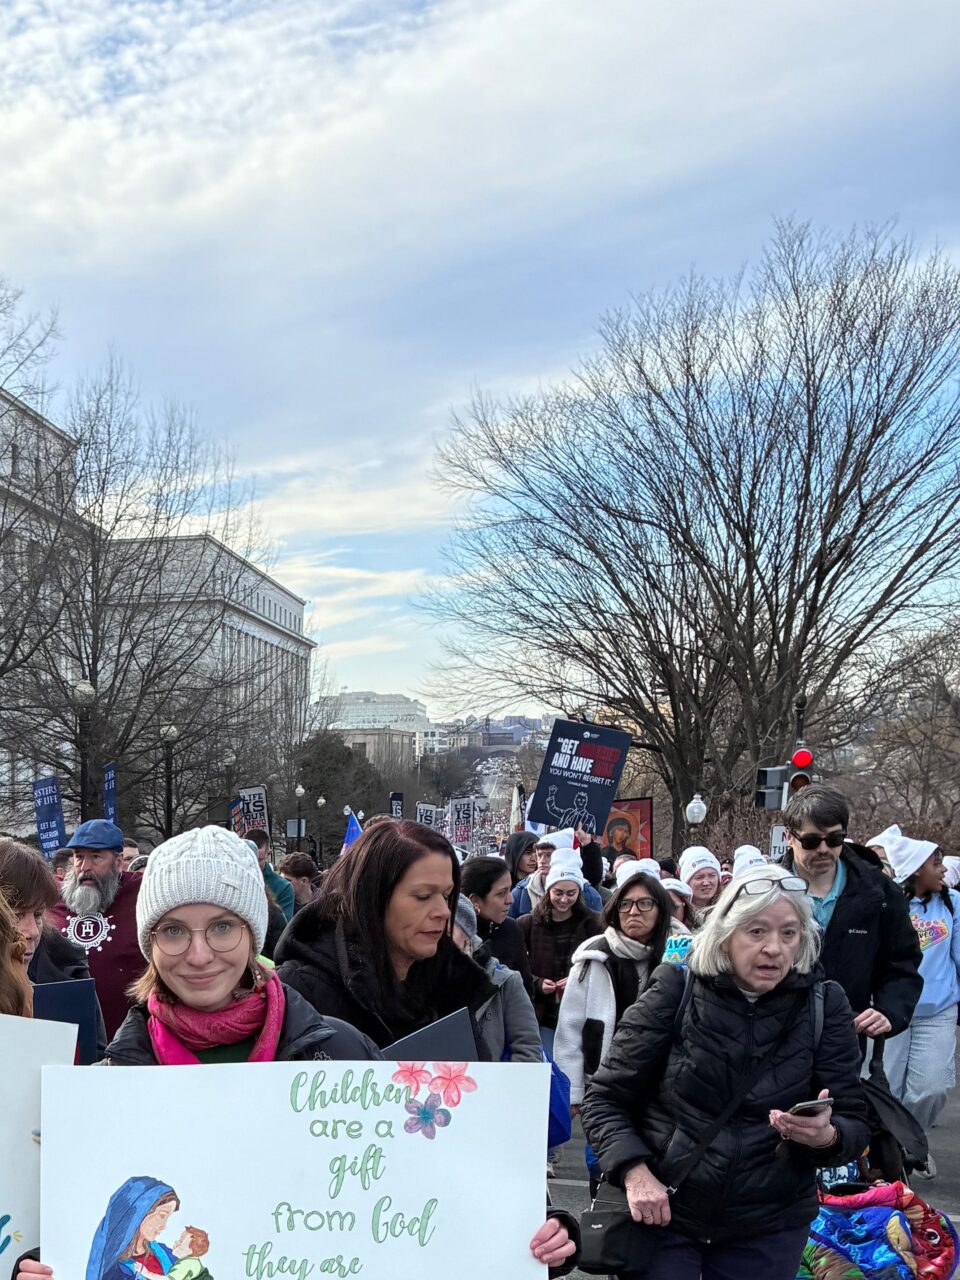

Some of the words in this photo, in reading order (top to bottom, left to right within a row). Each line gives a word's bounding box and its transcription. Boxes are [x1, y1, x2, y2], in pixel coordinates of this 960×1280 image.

[551, 752, 570, 768] AND
[570, 757, 594, 773] HAVE
[549, 767, 562, 776] YOU
[582, 773, 604, 784] REGRET
[43, 795, 58, 805] LIFE
[243, 793, 263, 801] LIFE
[244, 801, 265, 814] IS
[244, 812, 265, 820] OUR
[456, 809, 471, 819] IS
[420, 814, 433, 825] IS
[290, 1069, 414, 1113] Children
[310, 1118, 363, 1139] are
[375, 1118, 394, 1138] a
[329, 1144, 386, 1199] gift
[271, 1202, 355, 1233] from
[371, 1196, 438, 1247] God
[319, 1255, 363, 1278] are
